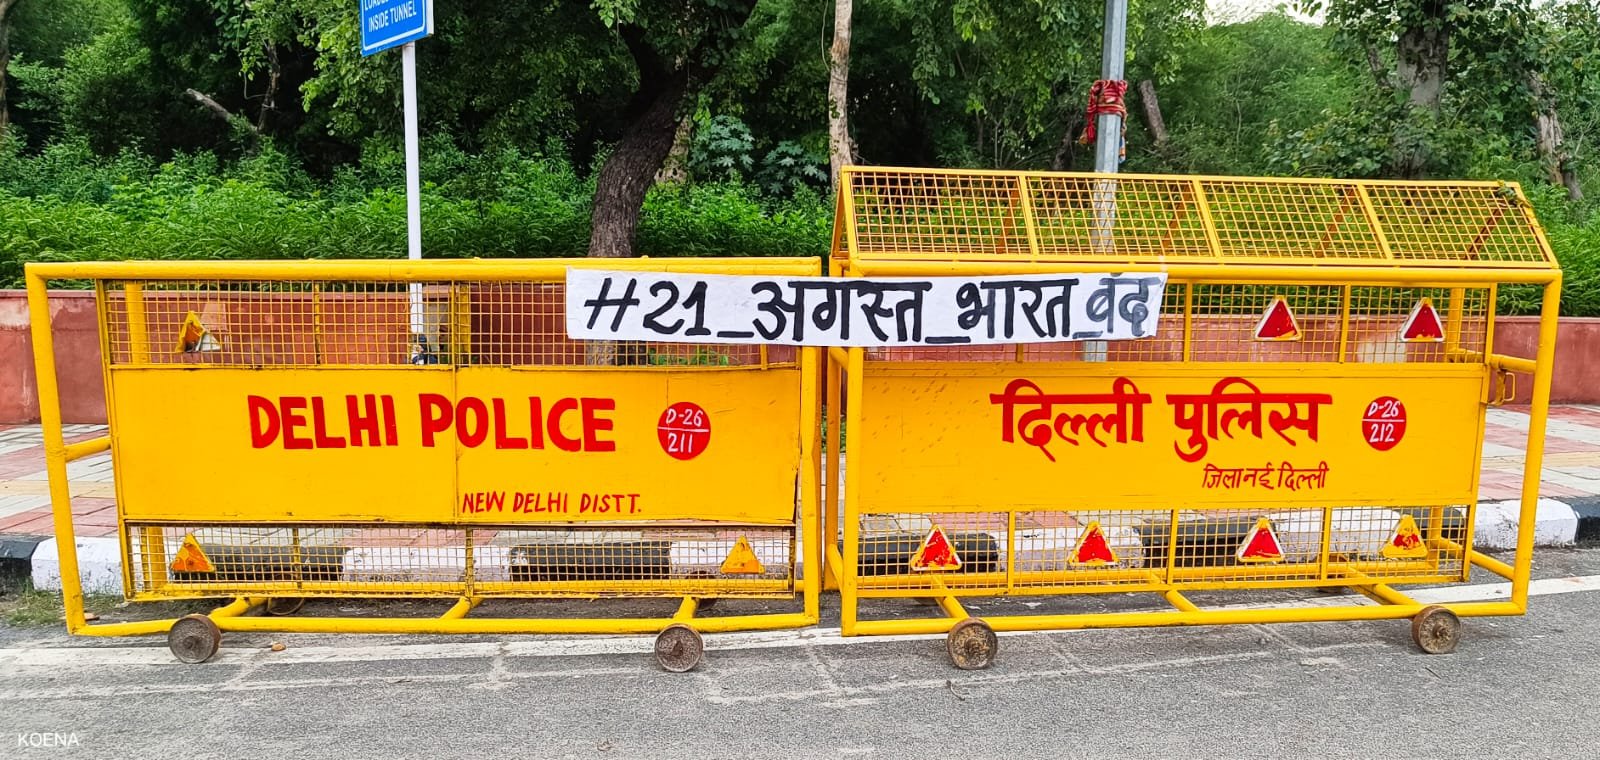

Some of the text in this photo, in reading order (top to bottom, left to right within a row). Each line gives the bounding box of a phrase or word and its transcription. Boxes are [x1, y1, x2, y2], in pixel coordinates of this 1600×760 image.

[368, 0, 417, 33] INSIDE TUNNEL
[666, 408, 703, 427] D-26
[989, 376, 1332, 463] दिल्ली पुलिस
[1368, 400, 1401, 418] D-26
[248, 393, 615, 452] DELHI POLICE
[1370, 423, 1395, 442] 212
[668, 433, 693, 453] 211
[1277, 461, 1330, 491] दिल्ली
[463, 491, 642, 514] NEW DELHI DISTT.
